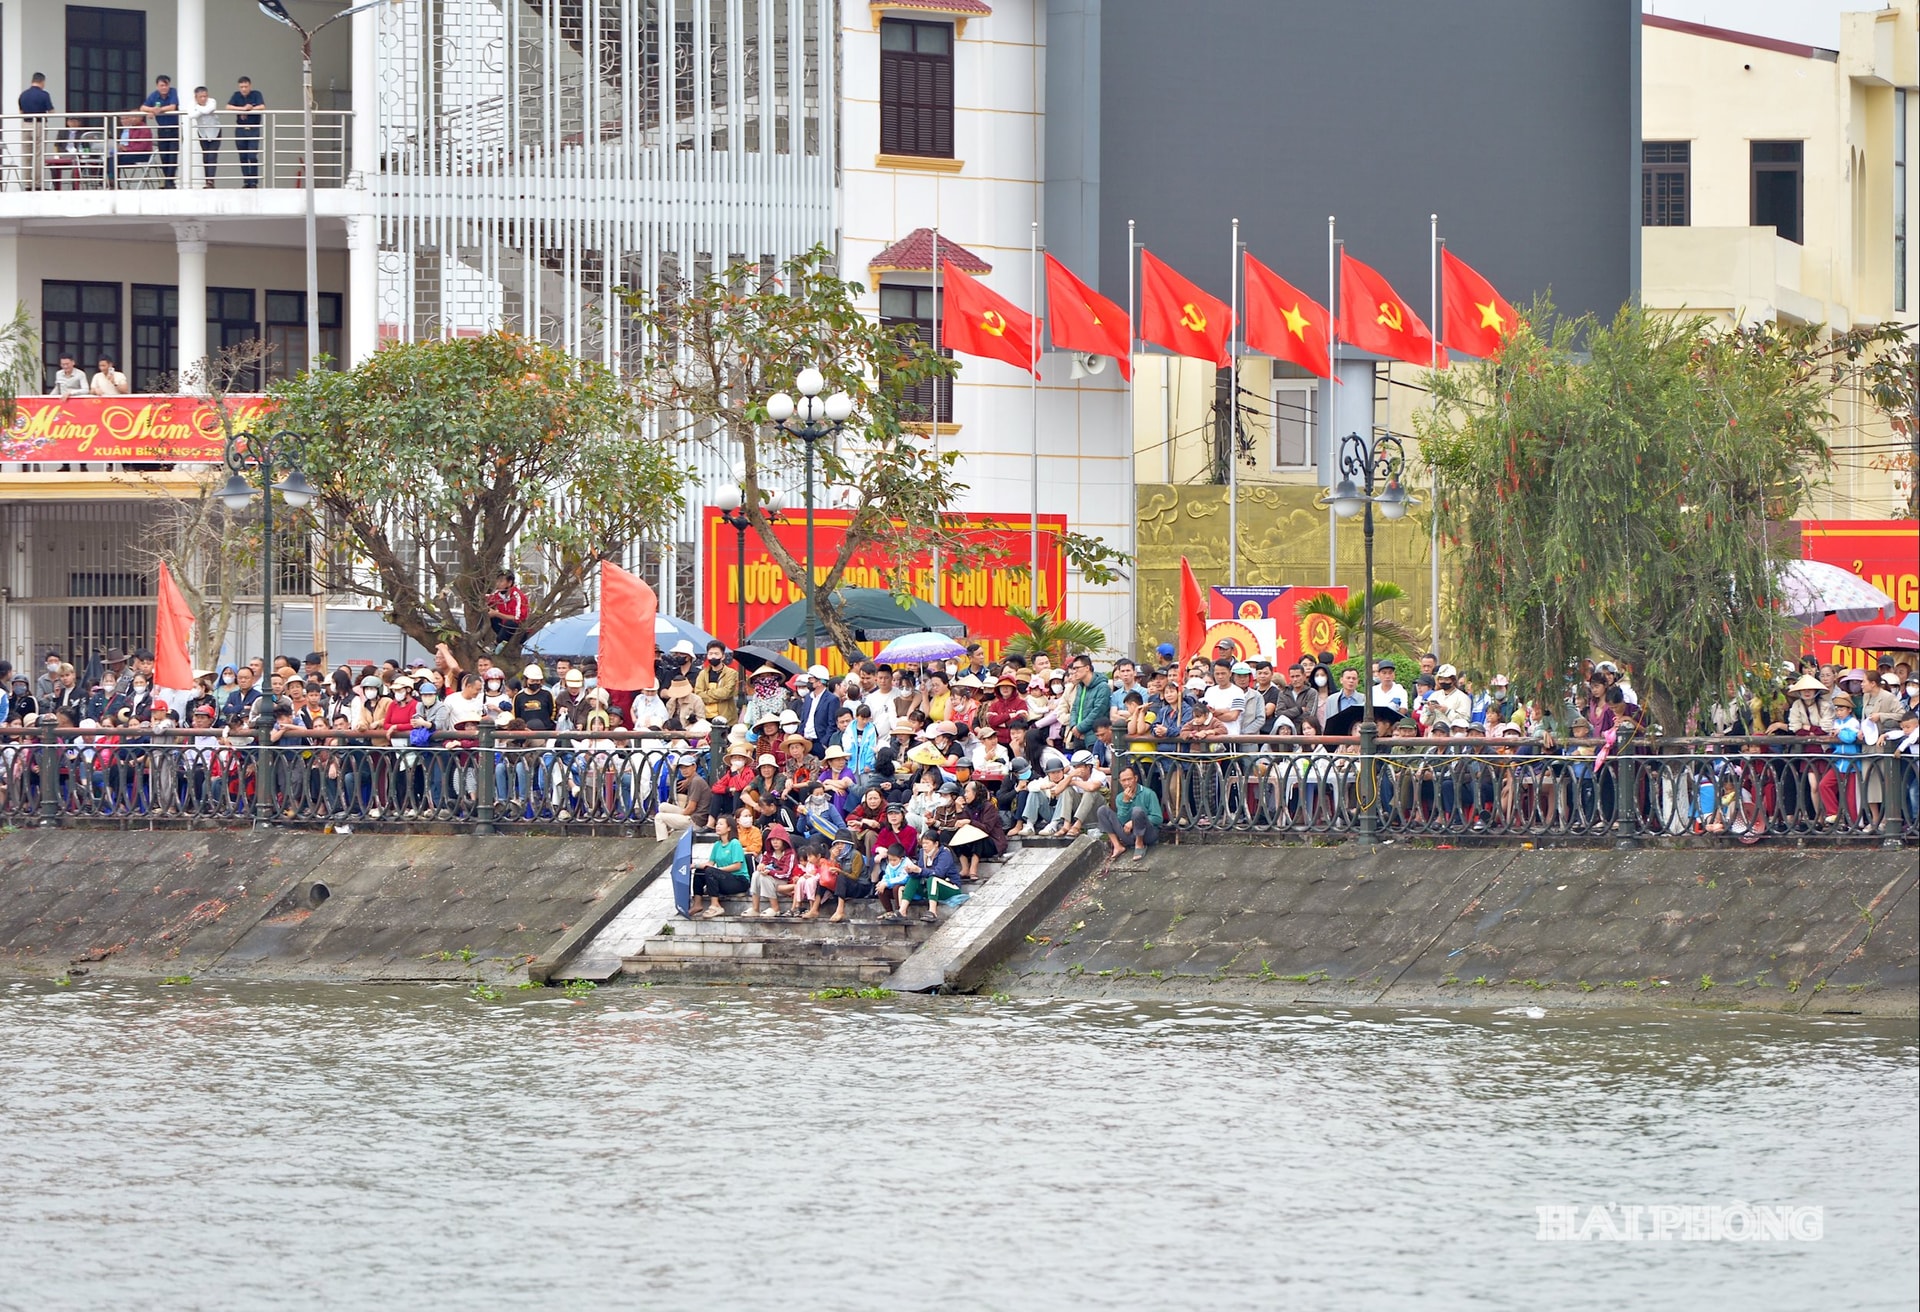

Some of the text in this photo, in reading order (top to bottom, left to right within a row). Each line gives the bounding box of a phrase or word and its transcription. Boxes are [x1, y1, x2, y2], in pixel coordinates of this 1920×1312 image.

[3, 404, 99, 452] Mừng
[102, 404, 192, 440] Năm
[94, 446, 131, 456] XUÂN
[728, 553, 782, 604] NƯỚC
